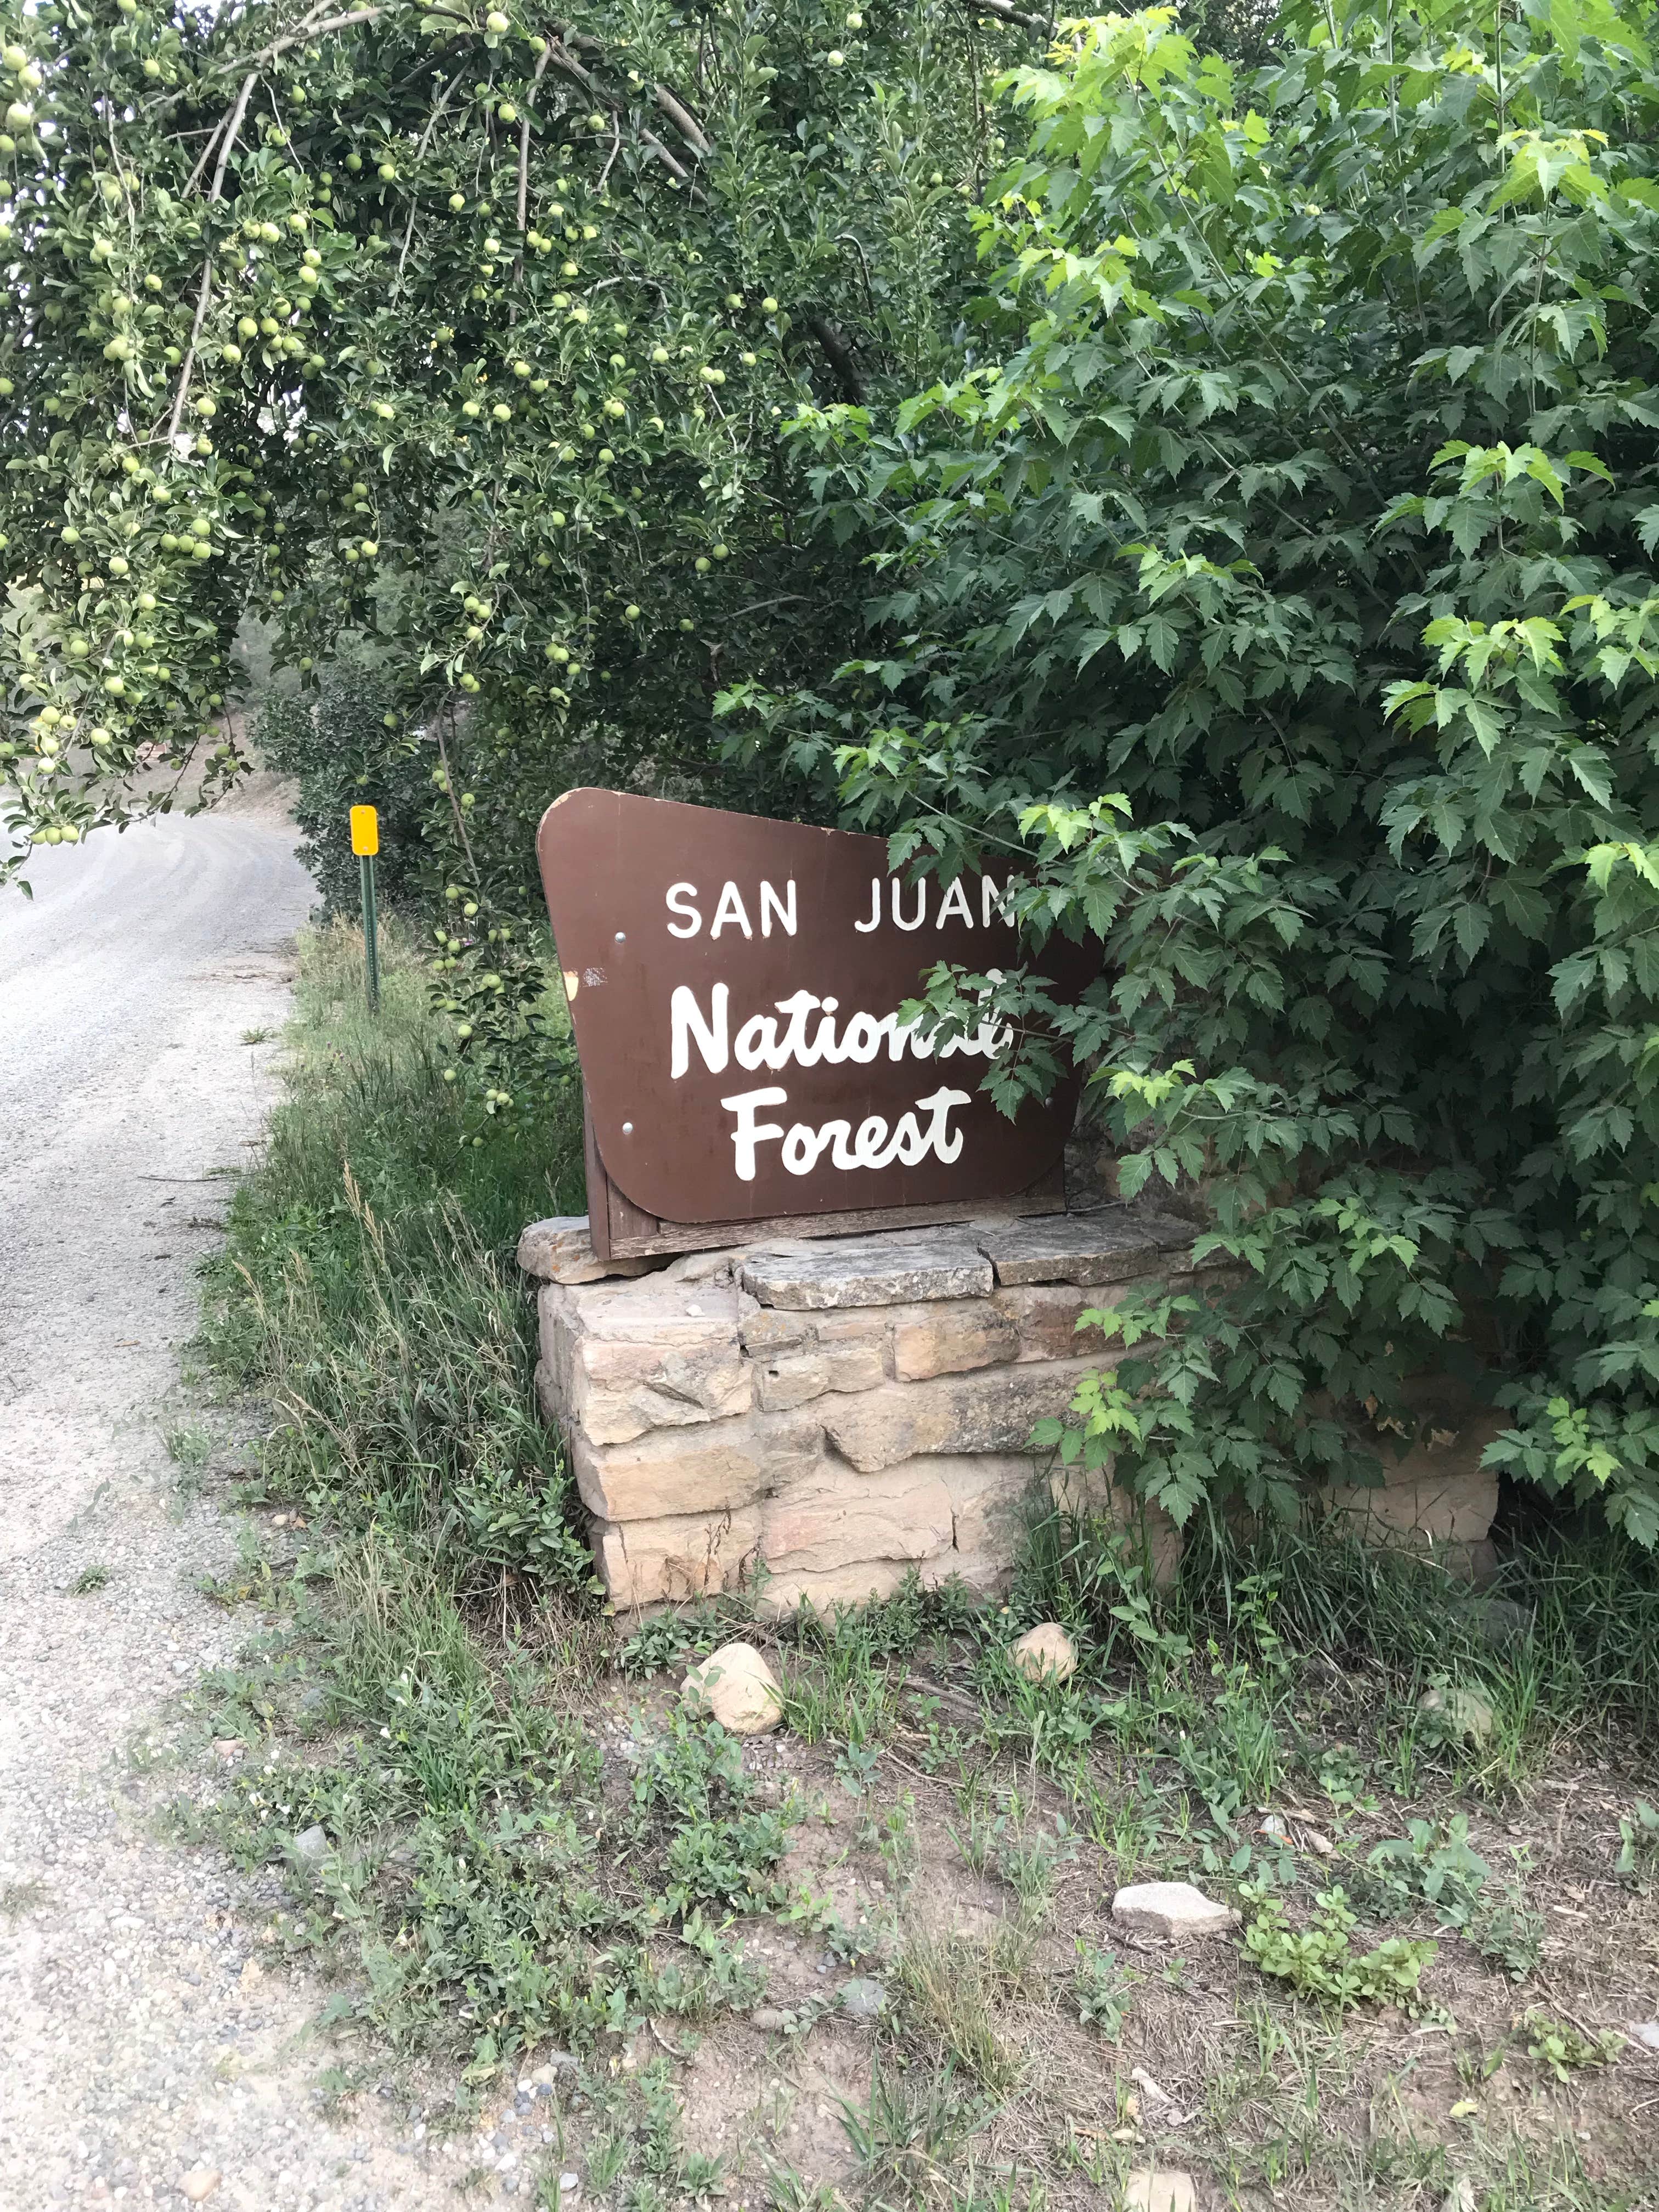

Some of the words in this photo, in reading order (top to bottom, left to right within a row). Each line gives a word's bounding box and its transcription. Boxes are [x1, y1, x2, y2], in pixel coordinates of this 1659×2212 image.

[665, 879, 797, 940] SAN
[854, 874, 1015, 933] JUAN
[720, 1086, 971, 1181] Forest
